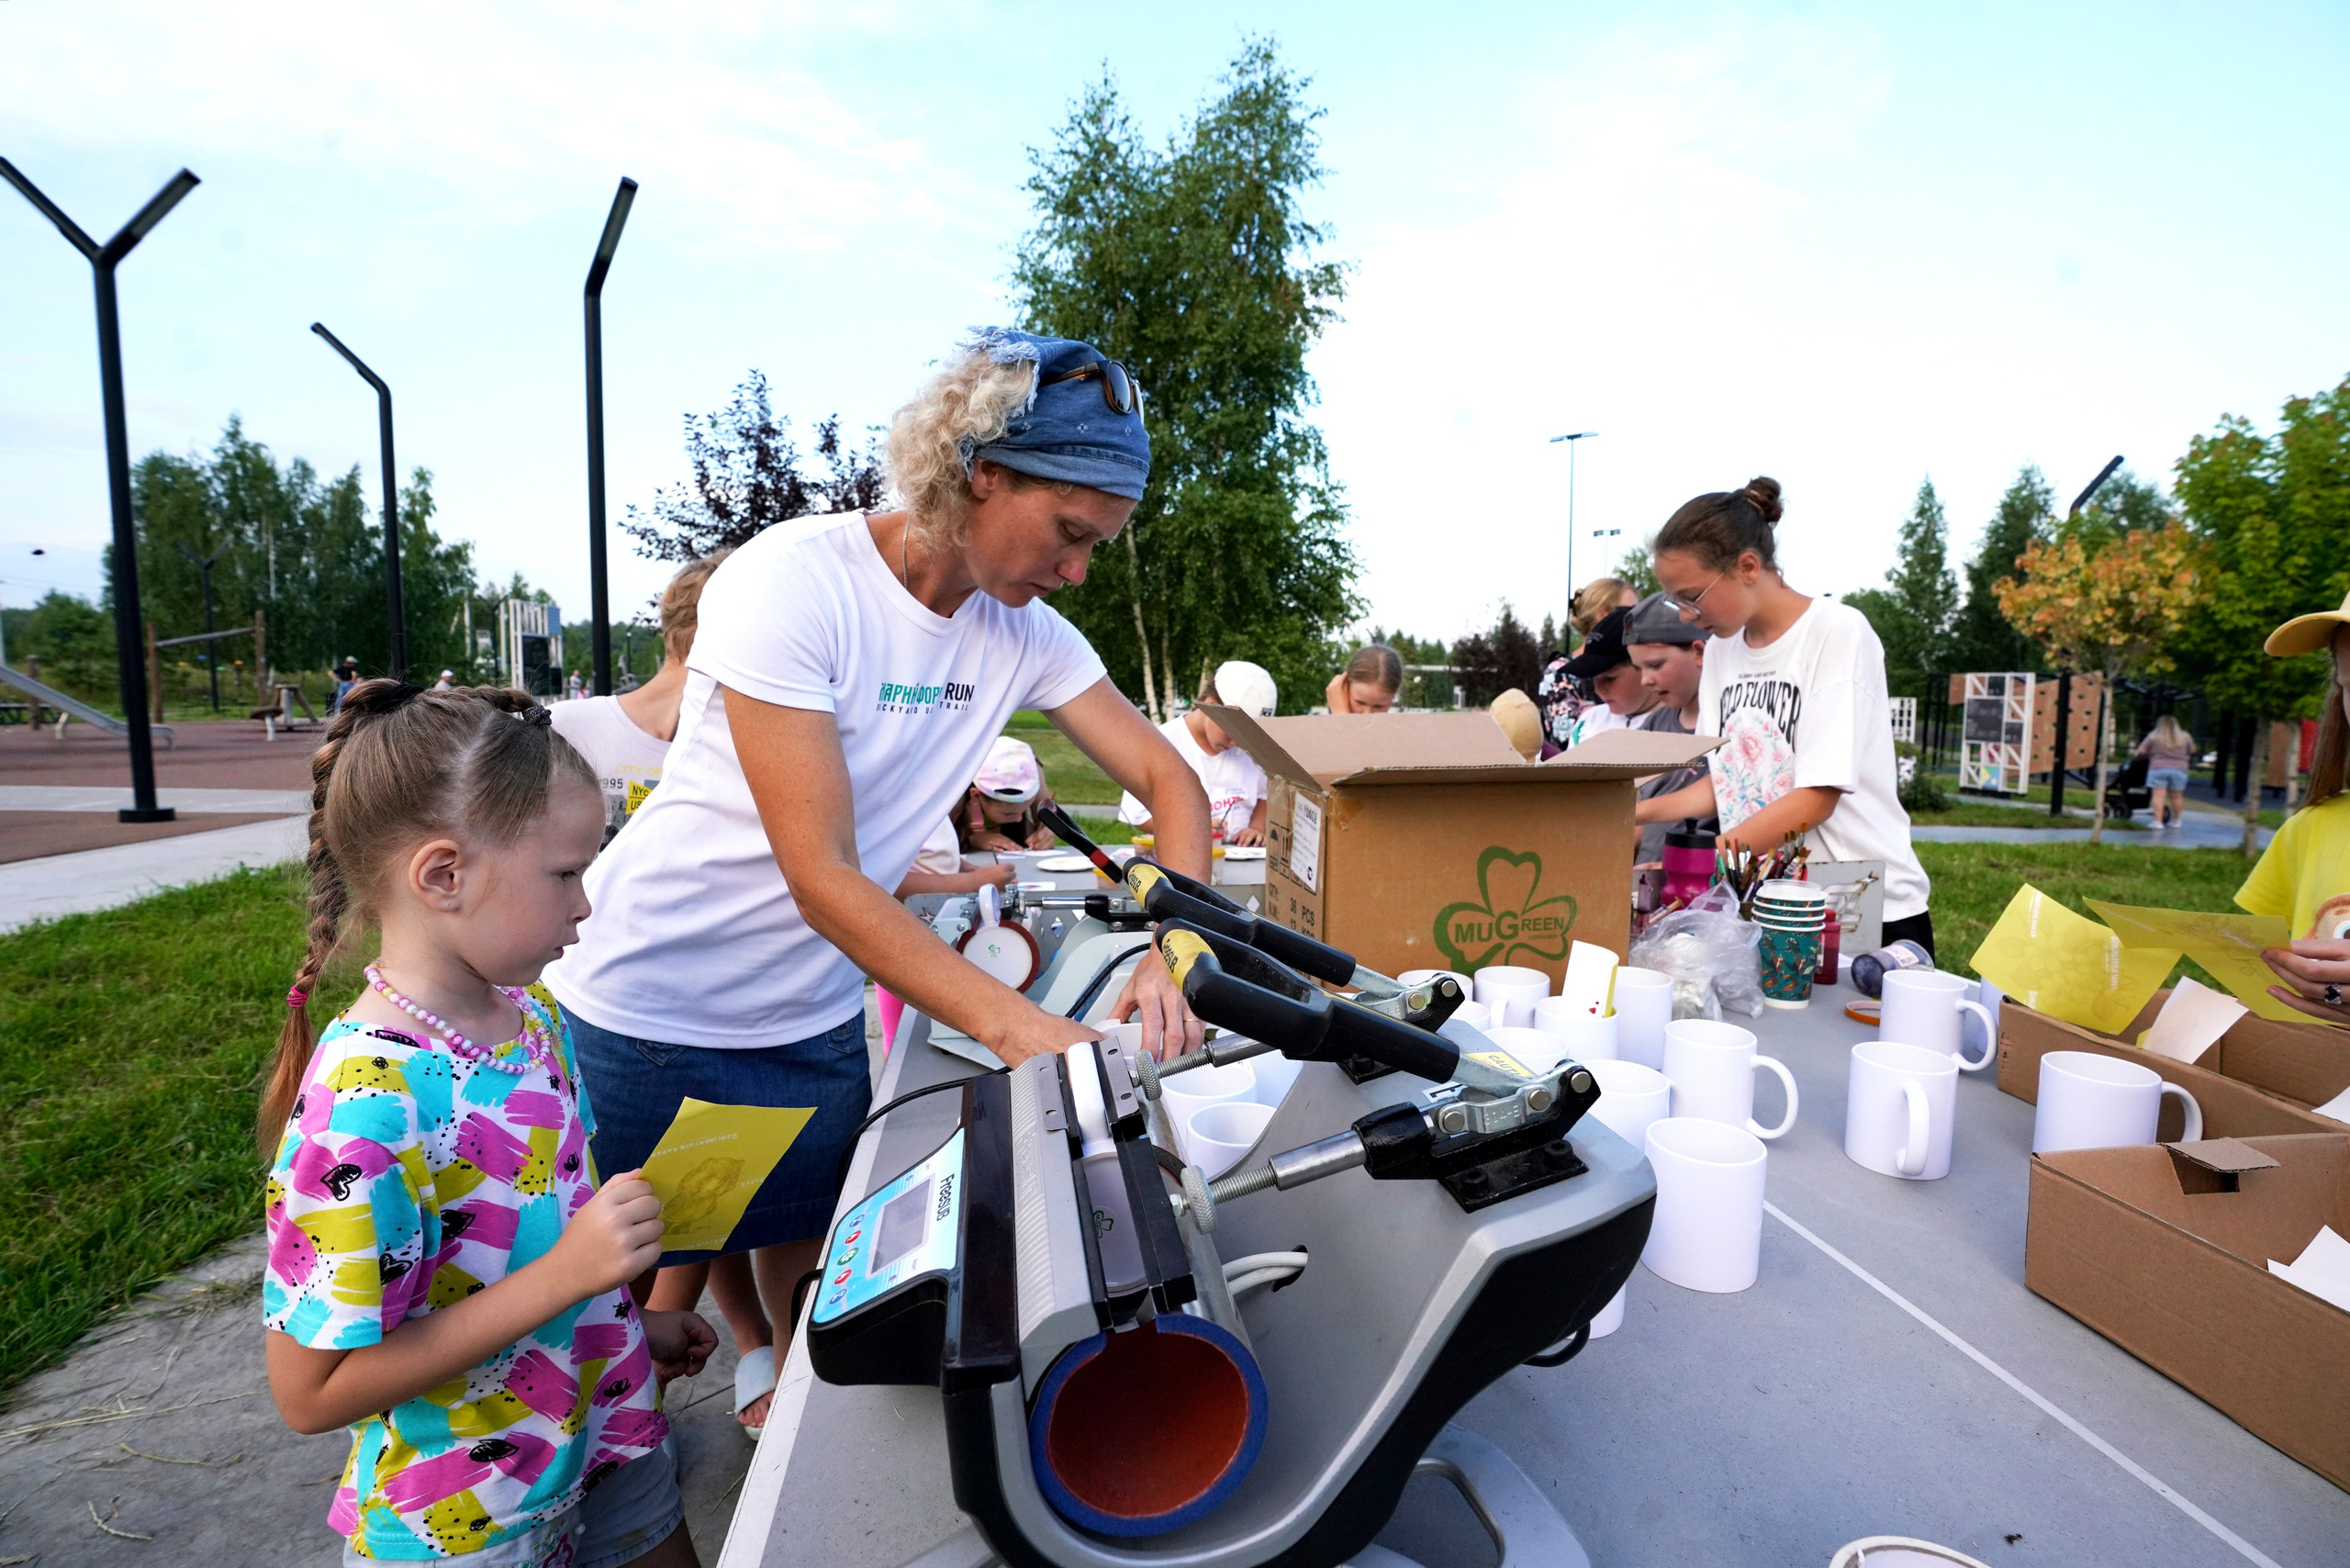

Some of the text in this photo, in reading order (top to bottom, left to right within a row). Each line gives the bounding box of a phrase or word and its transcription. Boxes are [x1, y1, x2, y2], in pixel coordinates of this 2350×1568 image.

[944, 682, 975, 702] RUN
[1743, 680, 1802, 754] FLOWER
[632, 784, 650, 797] NYC
[1302, 905, 1315, 927] PCS
